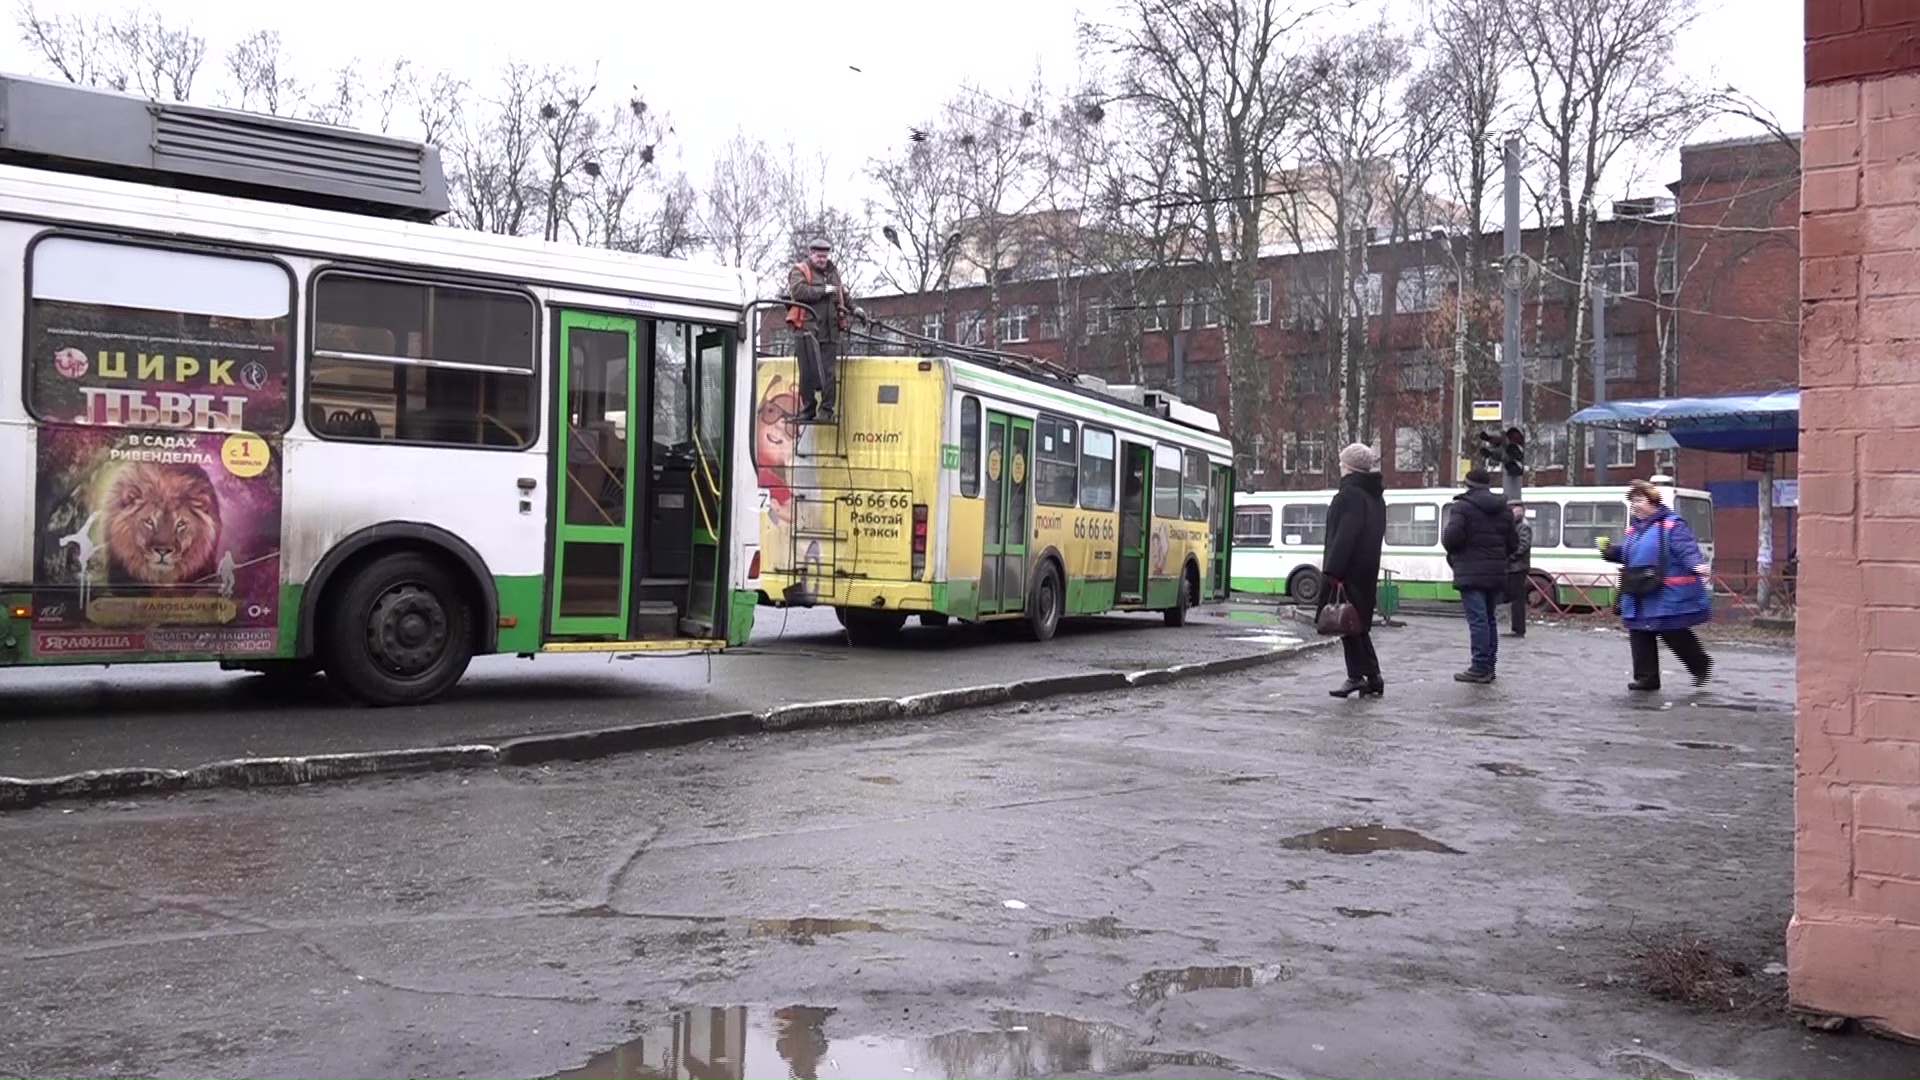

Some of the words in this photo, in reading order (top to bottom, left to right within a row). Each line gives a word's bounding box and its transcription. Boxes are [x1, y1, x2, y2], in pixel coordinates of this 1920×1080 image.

[97, 350, 236, 386] ЦИРК
[75, 387, 248, 432] ЛЬВЫ
[128, 435, 139, 446] В
[144, 436, 197, 449] САДАХ
[853, 430, 899, 444] maxim
[110, 449, 213, 464] РИВЕНДЕЛЛА
[241, 441, 250, 457] 1
[867, 494, 885, 508] 66
[890, 495, 908, 509] 66
[851, 512, 903, 525] Работай
[864, 528, 899, 538] такси
[45, 635, 131, 650] ЯРАФИША
